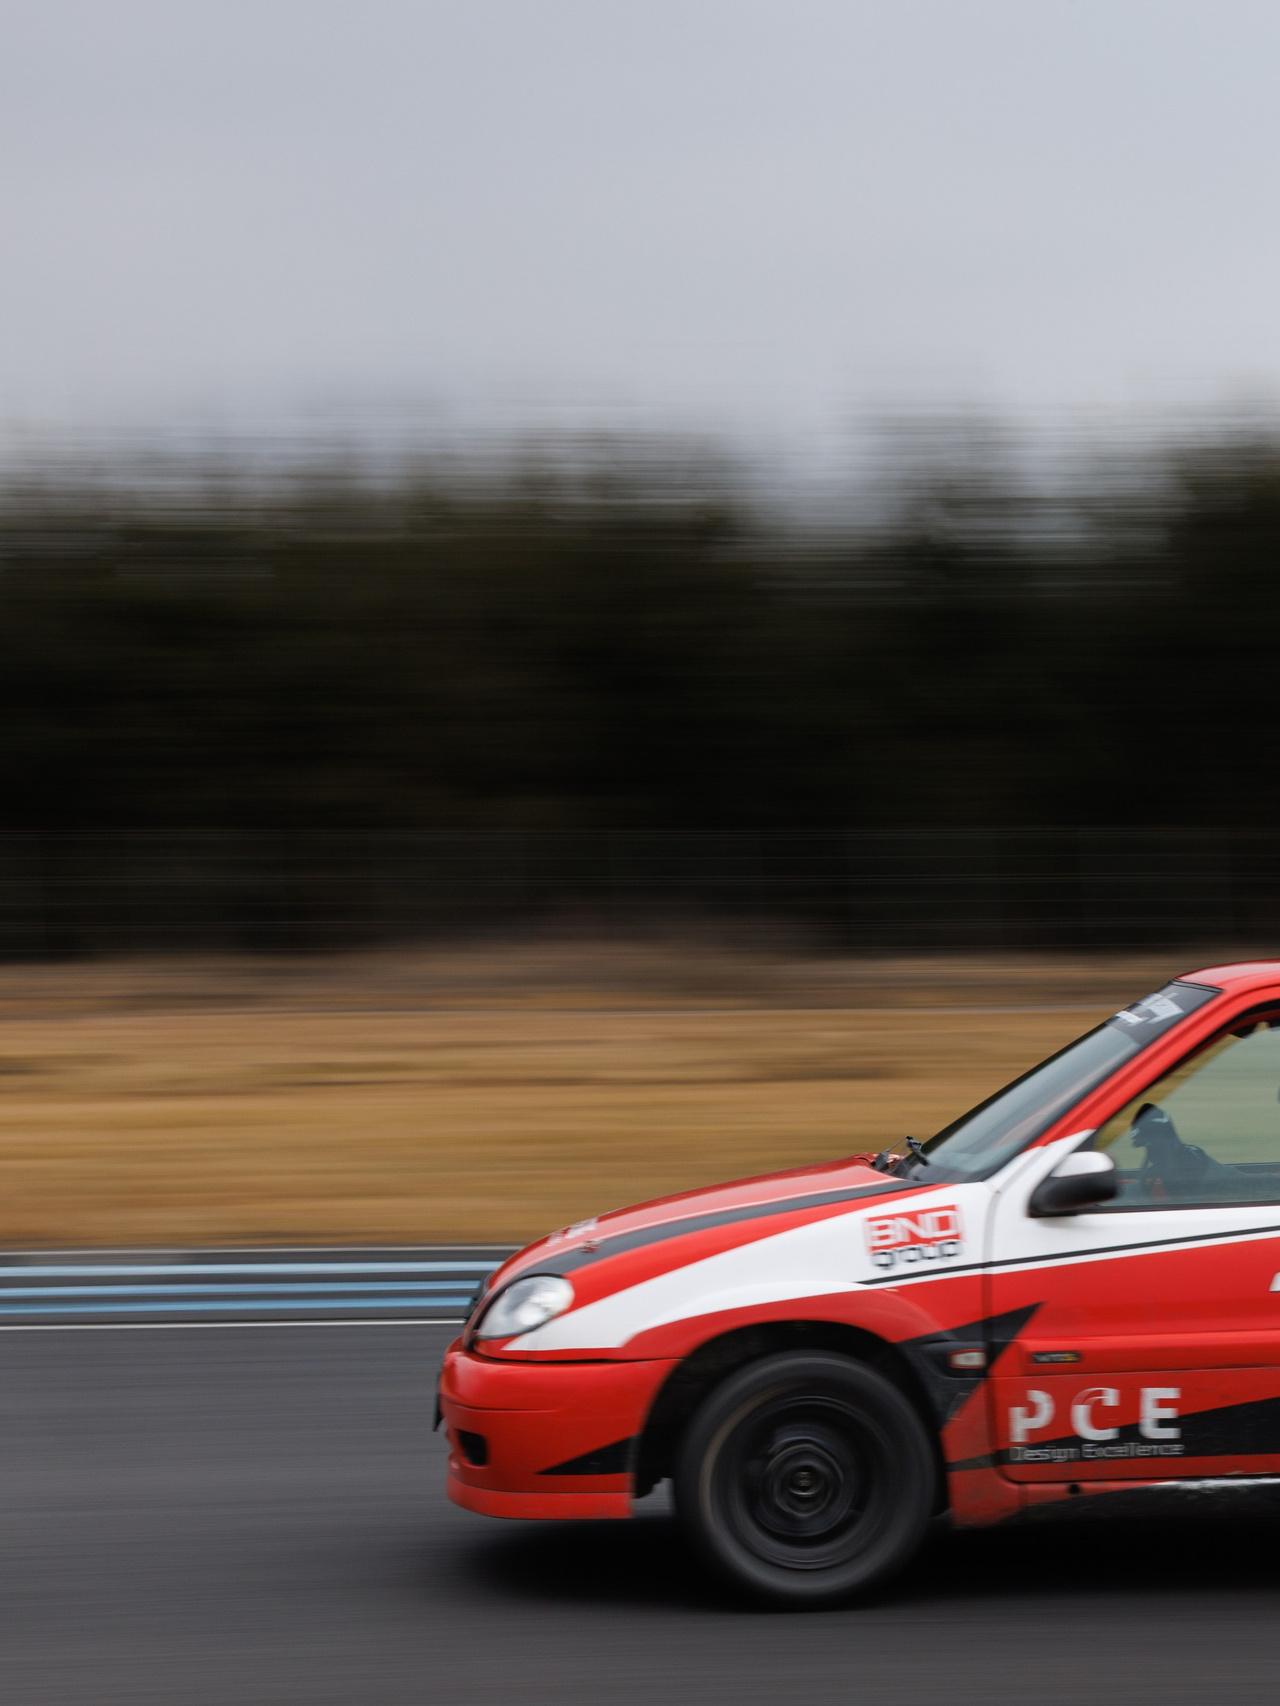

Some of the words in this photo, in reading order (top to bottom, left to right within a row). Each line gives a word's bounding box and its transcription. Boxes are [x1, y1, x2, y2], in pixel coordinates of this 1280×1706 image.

[1008, 1387, 1182, 1442] PCE
[1009, 1445, 1080, 1463] Design
[1081, 1442, 1186, 1459] Excellence
